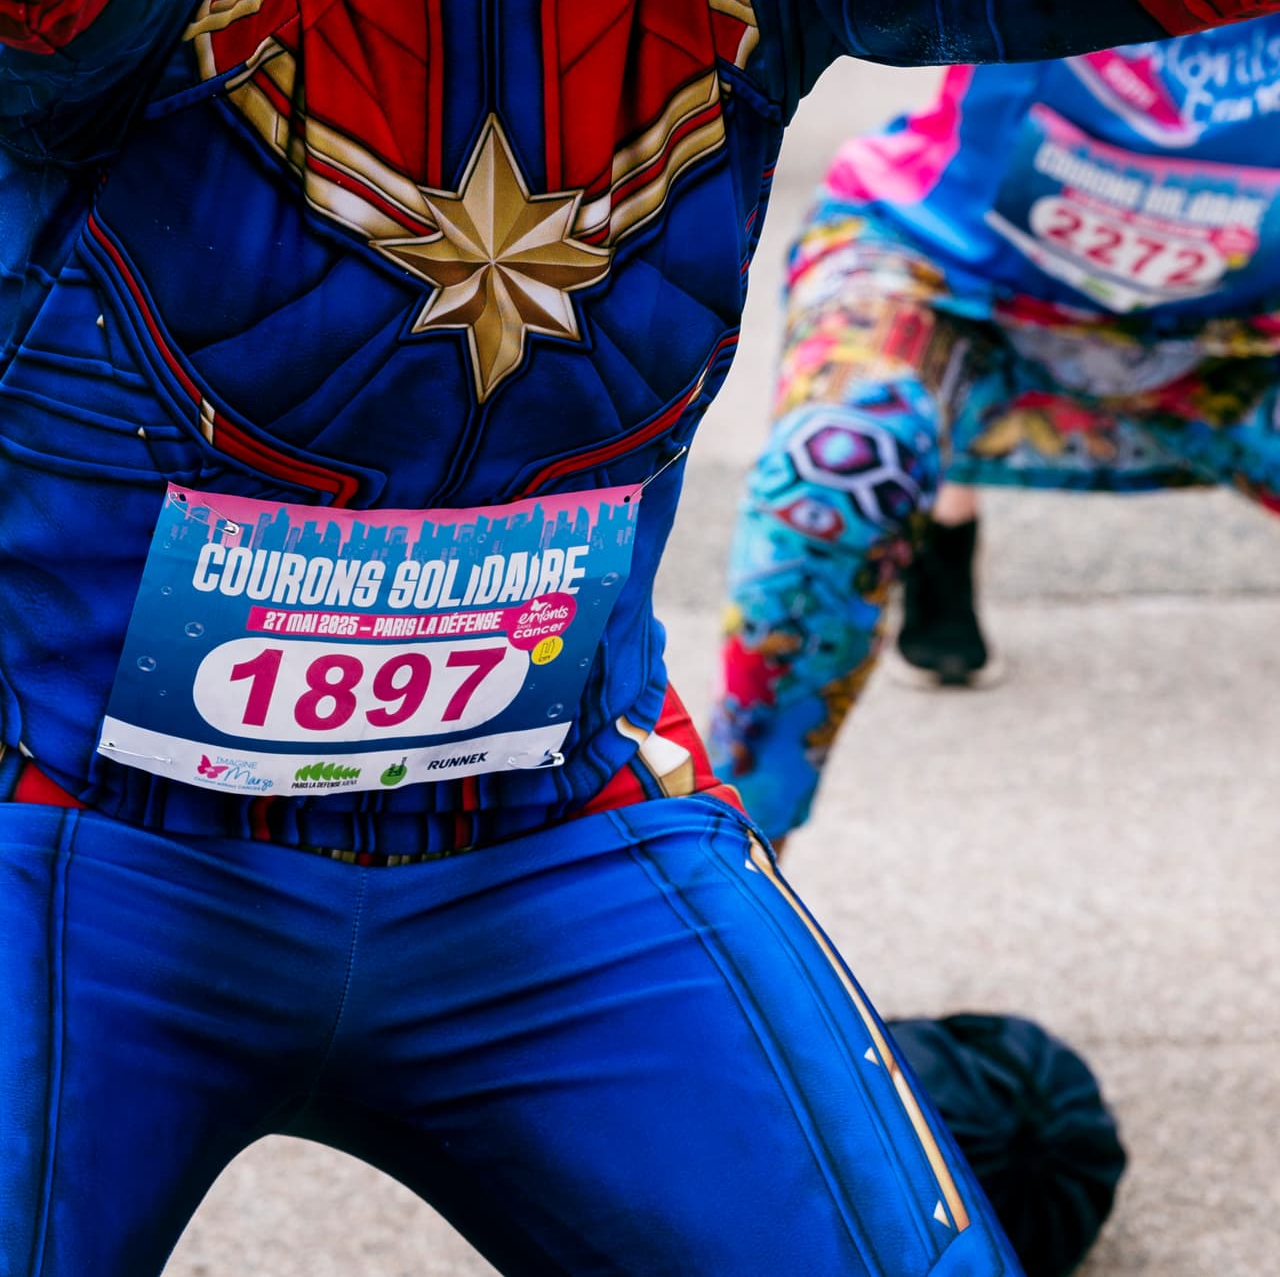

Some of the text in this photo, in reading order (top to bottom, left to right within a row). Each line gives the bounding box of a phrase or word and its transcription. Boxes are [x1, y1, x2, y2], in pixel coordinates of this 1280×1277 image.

[1046, 207, 1206, 288] 2272
[192, 542, 590, 610] COURONS SOLIDAIRE
[263, 610, 283, 631] 27
[287, 613, 317, 633] MAI
[318, 615, 360, 636] 2025
[372, 616, 420, 637] PARIS
[416, 615, 440, 636] LA
[437, 609, 504, 633] DÉFENSE
[518, 603, 569, 624] enfants
[513, 622, 565, 639] cancer
[229, 646, 508, 732] 1897
[215, 756, 258, 770] IMAGINE
[427, 751, 489, 770] RUNNEK
[224, 766, 274, 792] Margo
